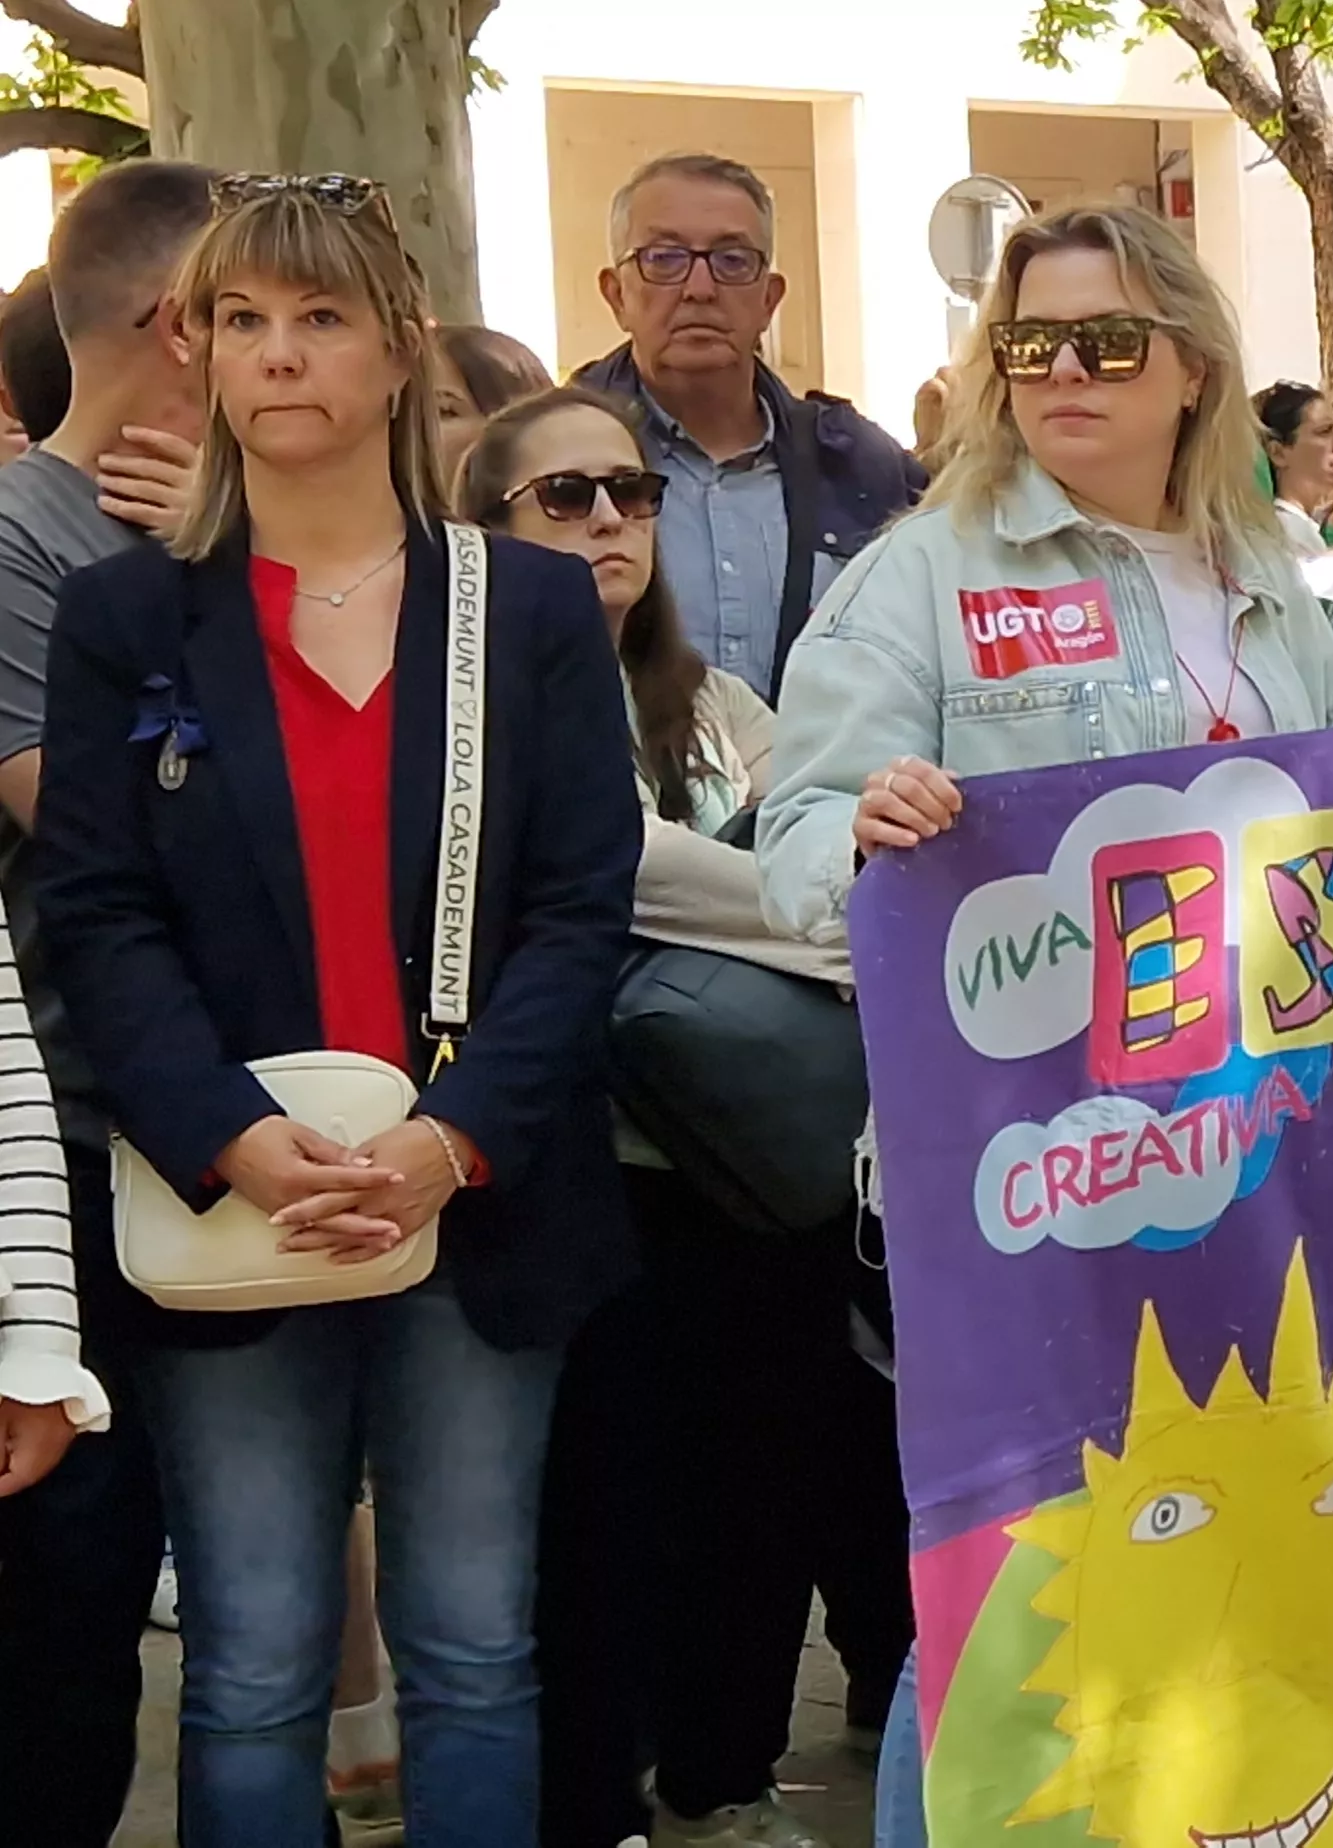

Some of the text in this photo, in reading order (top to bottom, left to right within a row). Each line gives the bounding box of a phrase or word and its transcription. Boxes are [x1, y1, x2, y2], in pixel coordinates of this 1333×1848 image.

[453, 527, 478, 692] CASADEMUNT
[969, 605, 1046, 645] UGT
[438, 721, 475, 1014] LOLA CASADEMUNT
[957, 911, 1093, 1011] VIVA
[1002, 1065, 1314, 1230] CREATIVA
